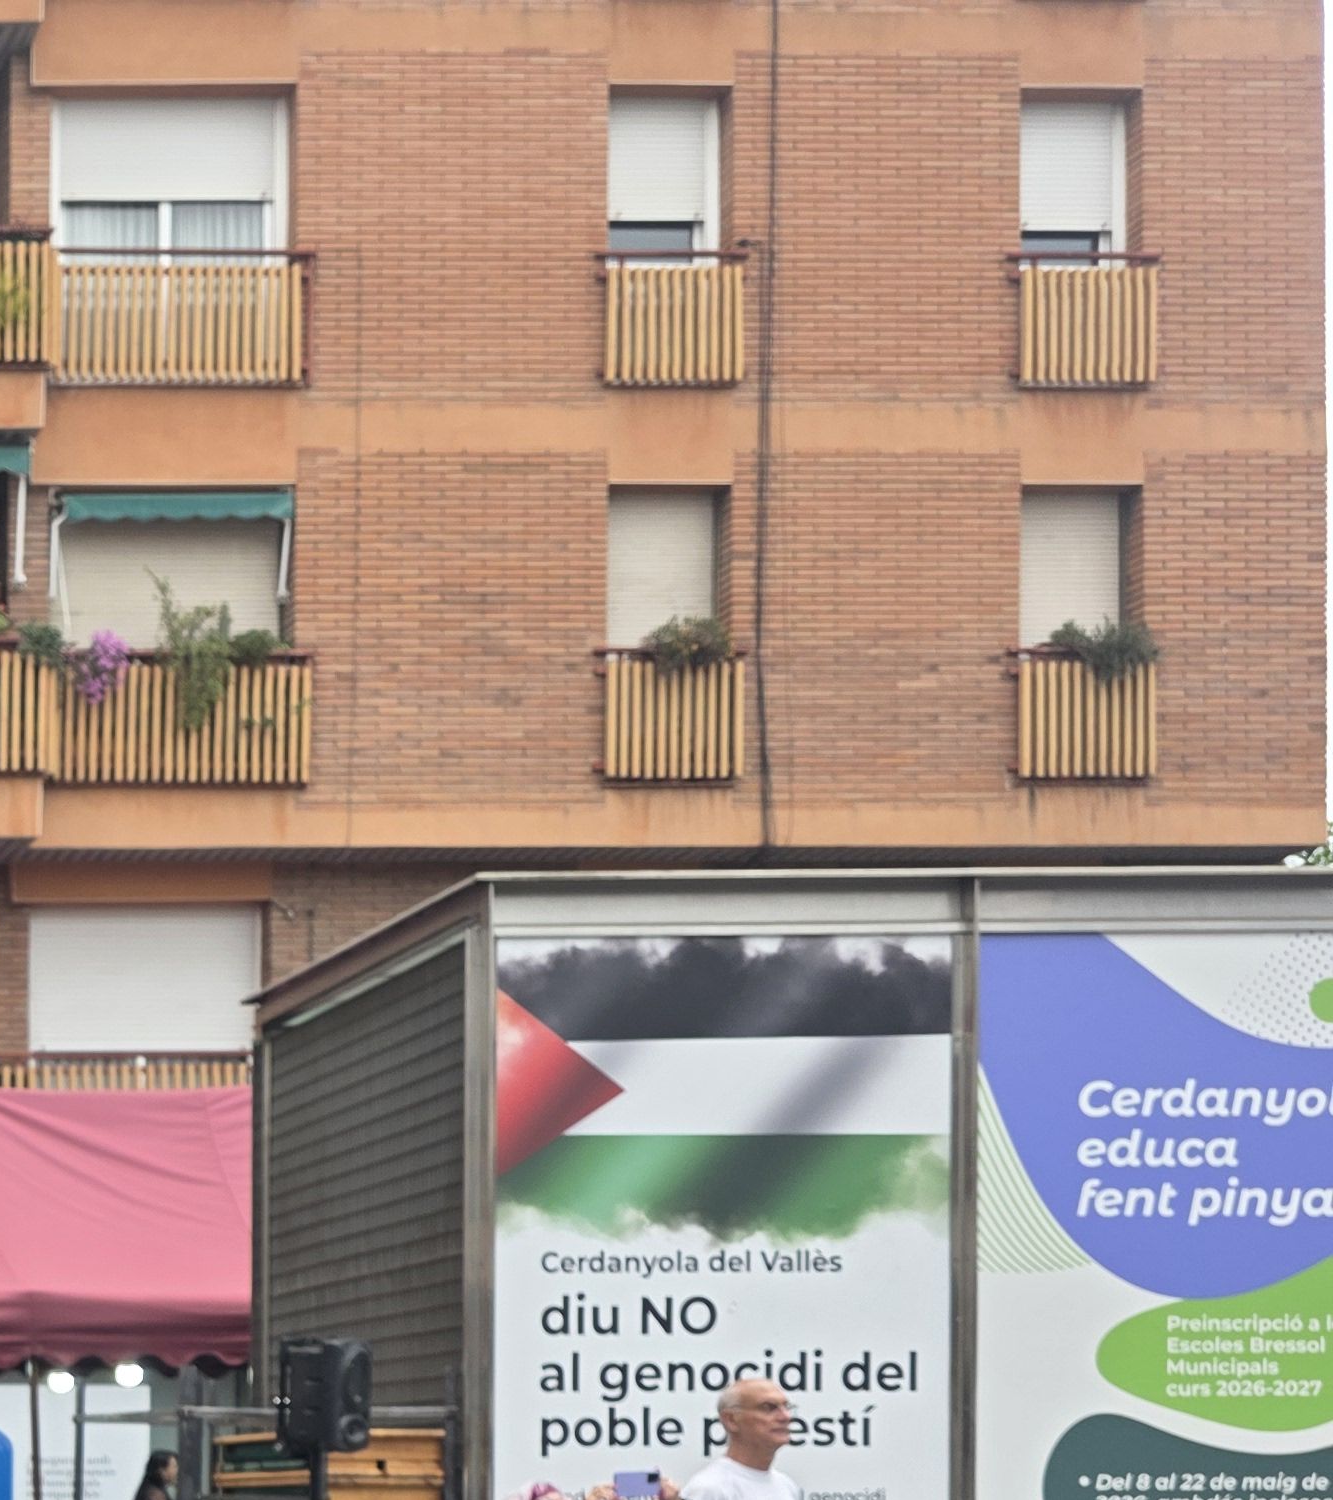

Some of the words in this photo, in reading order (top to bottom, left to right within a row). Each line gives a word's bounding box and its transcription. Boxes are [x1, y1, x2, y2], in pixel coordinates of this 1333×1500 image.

[1076, 1127, 1240, 1168] educa
[1076, 1176, 1179, 1218] fent
[1187, 1175, 1333, 1227] pinya
[540, 1250, 700, 1278] Cerdanyola
[709, 1250, 752, 1273] del
[760, 1250, 844, 1273] Vallès
[540, 1293, 620, 1335] diu
[640, 1295, 718, 1335] NO
[1166, 1313, 1302, 1335] Preinscripció
[1307, 1318, 1321, 1333] a
[1326, 1314, 1333, 1333] l
[1166, 1335, 1244, 1354] Escoles
[1249, 1335, 1326, 1354] Bressol
[539, 1351, 580, 1392] al
[599, 1349, 823, 1402] genocidi
[842, 1350, 918, 1392] del
[1166, 1357, 1280, 1379] Municipals
[1165, 1383, 1211, 1398] curs
[1215, 1379, 1323, 1398] 2026-2027
[540, 1406, 685, 1458] poble
[703, 1405, 877, 1458] pestí
[1094, 1472, 1132, 1492] Del
[1136, 1473, 1152, 1492] 8
[1154, 1471, 1177, 1492] al
[1179, 1473, 1205, 1492] 22
[1209, 1471, 1237, 1491] de
[1241, 1471, 1297, 1495] maig
[1301, 1471, 1330, 1491] de
